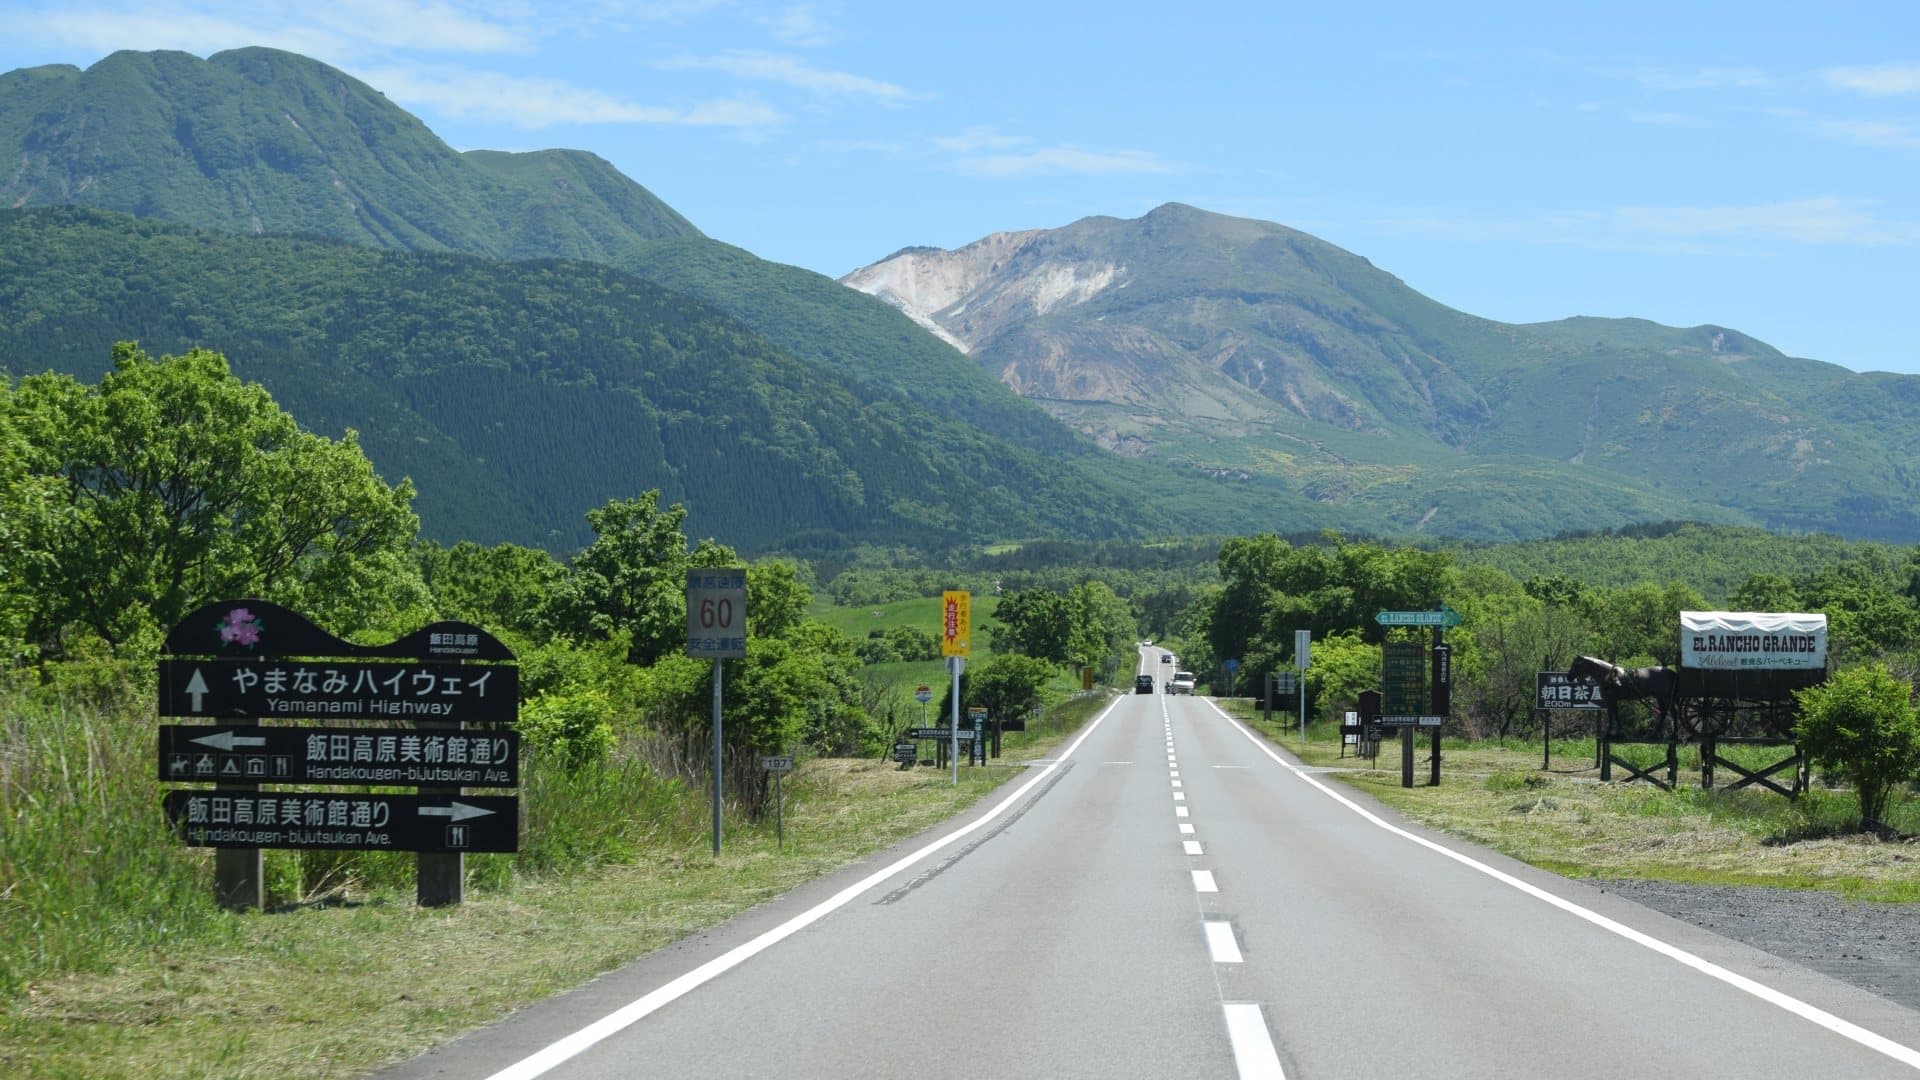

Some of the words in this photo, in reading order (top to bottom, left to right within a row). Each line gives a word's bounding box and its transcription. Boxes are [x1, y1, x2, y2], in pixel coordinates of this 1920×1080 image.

[700, 598, 732, 628] 60
[429, 633, 478, 647] 飯田高原
[1693, 637, 1707, 652] EL
[1708, 634, 1760, 652] RANCHO
[1762, 635, 1816, 653] GRANDE
[231, 668, 492, 697] やまなみハイウェイ
[1540, 685, 1602, 701] 朝日茶屋
[267, 698, 362, 713] Yamanami
[370, 699, 453, 715] Highway
[1544, 700, 1572, 708] 200m
[306, 734, 509, 765] 飯田高原美術館通り
[306, 765, 480, 782] Handakougen-bijutsukan
[483, 768, 511, 782] Ave.
[187, 797, 390, 828] 飯田高原美術館通り
[187, 827, 362, 845] Handakougen-bijutsukan
[365, 831, 392, 845] Ave.
